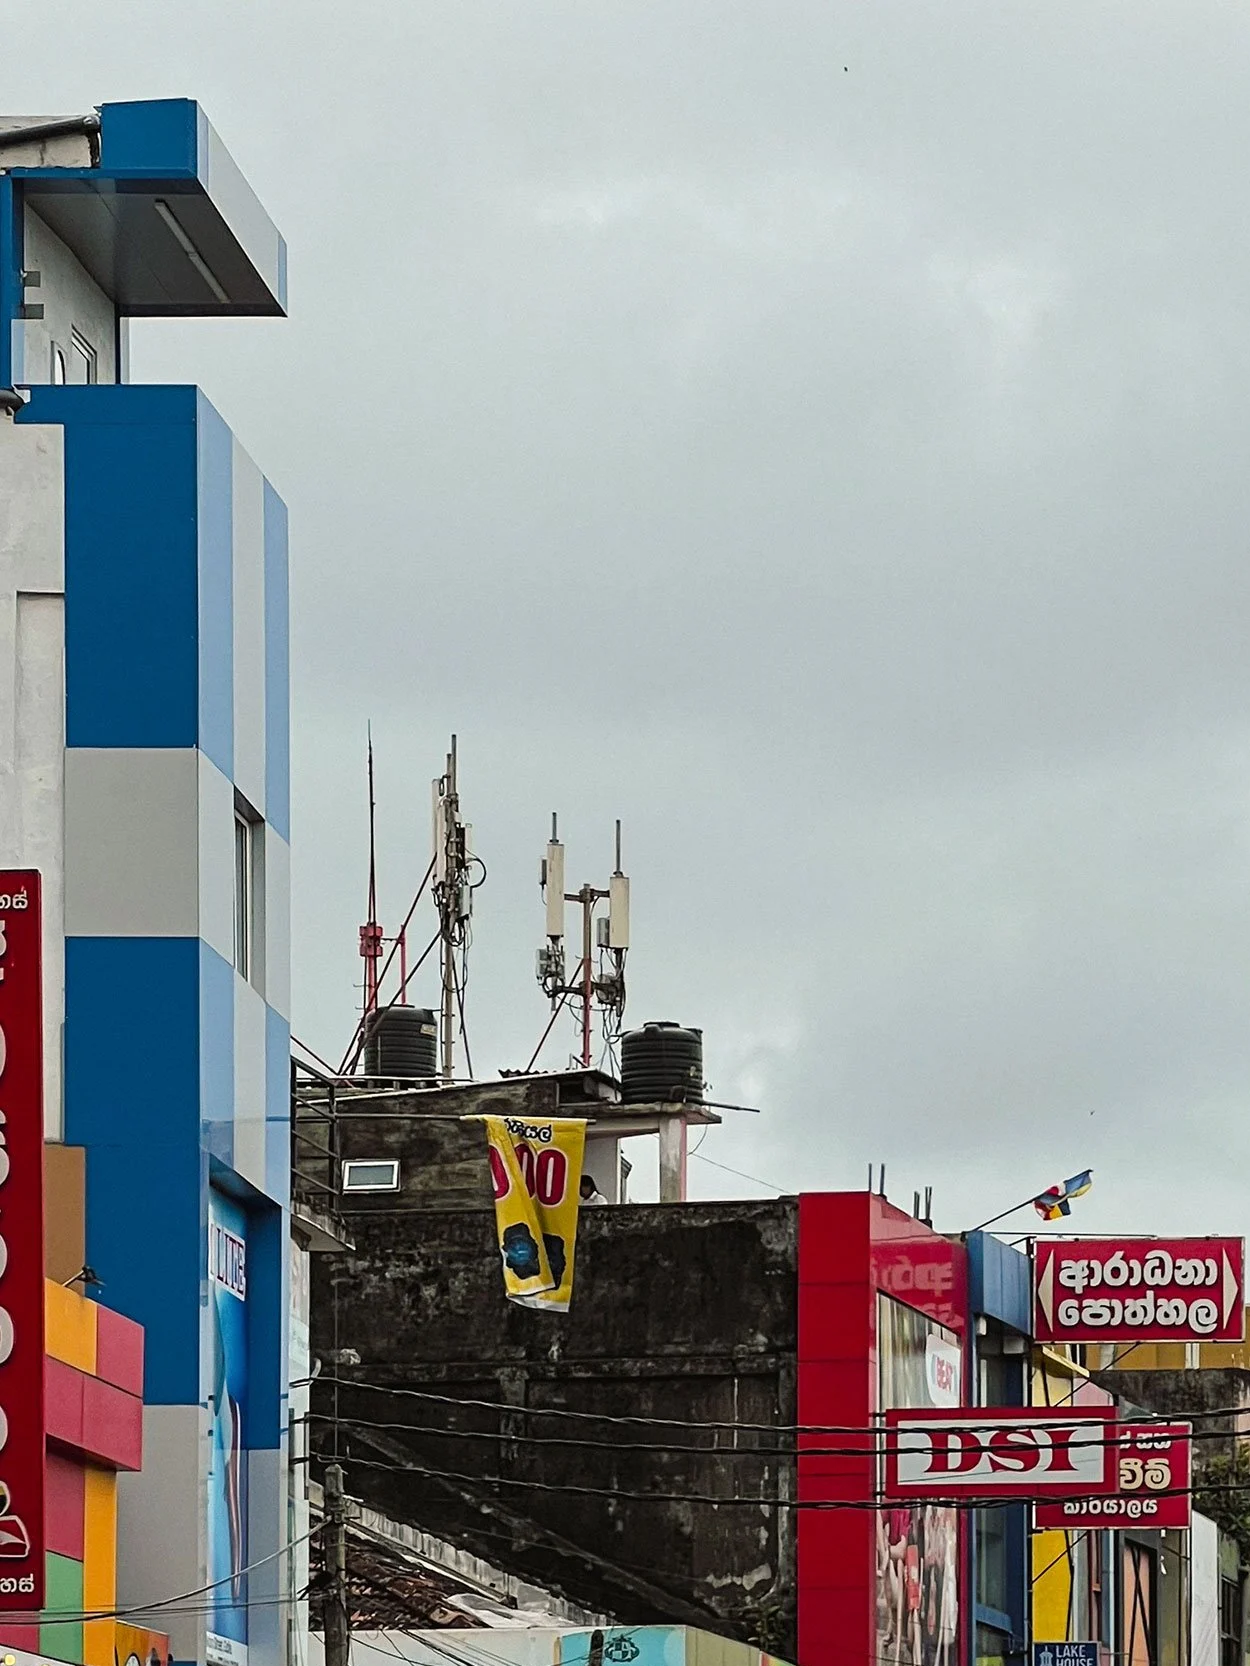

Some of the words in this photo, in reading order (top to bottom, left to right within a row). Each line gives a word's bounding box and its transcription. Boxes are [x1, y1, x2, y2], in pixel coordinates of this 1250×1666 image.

[1058, 1250, 1219, 1294] ආරාධනා
[1058, 1290, 1219, 1334] පොත්හල
[924, 1429, 1080, 1474] DSI
[1056, 1645, 1086, 1658] LAKE
